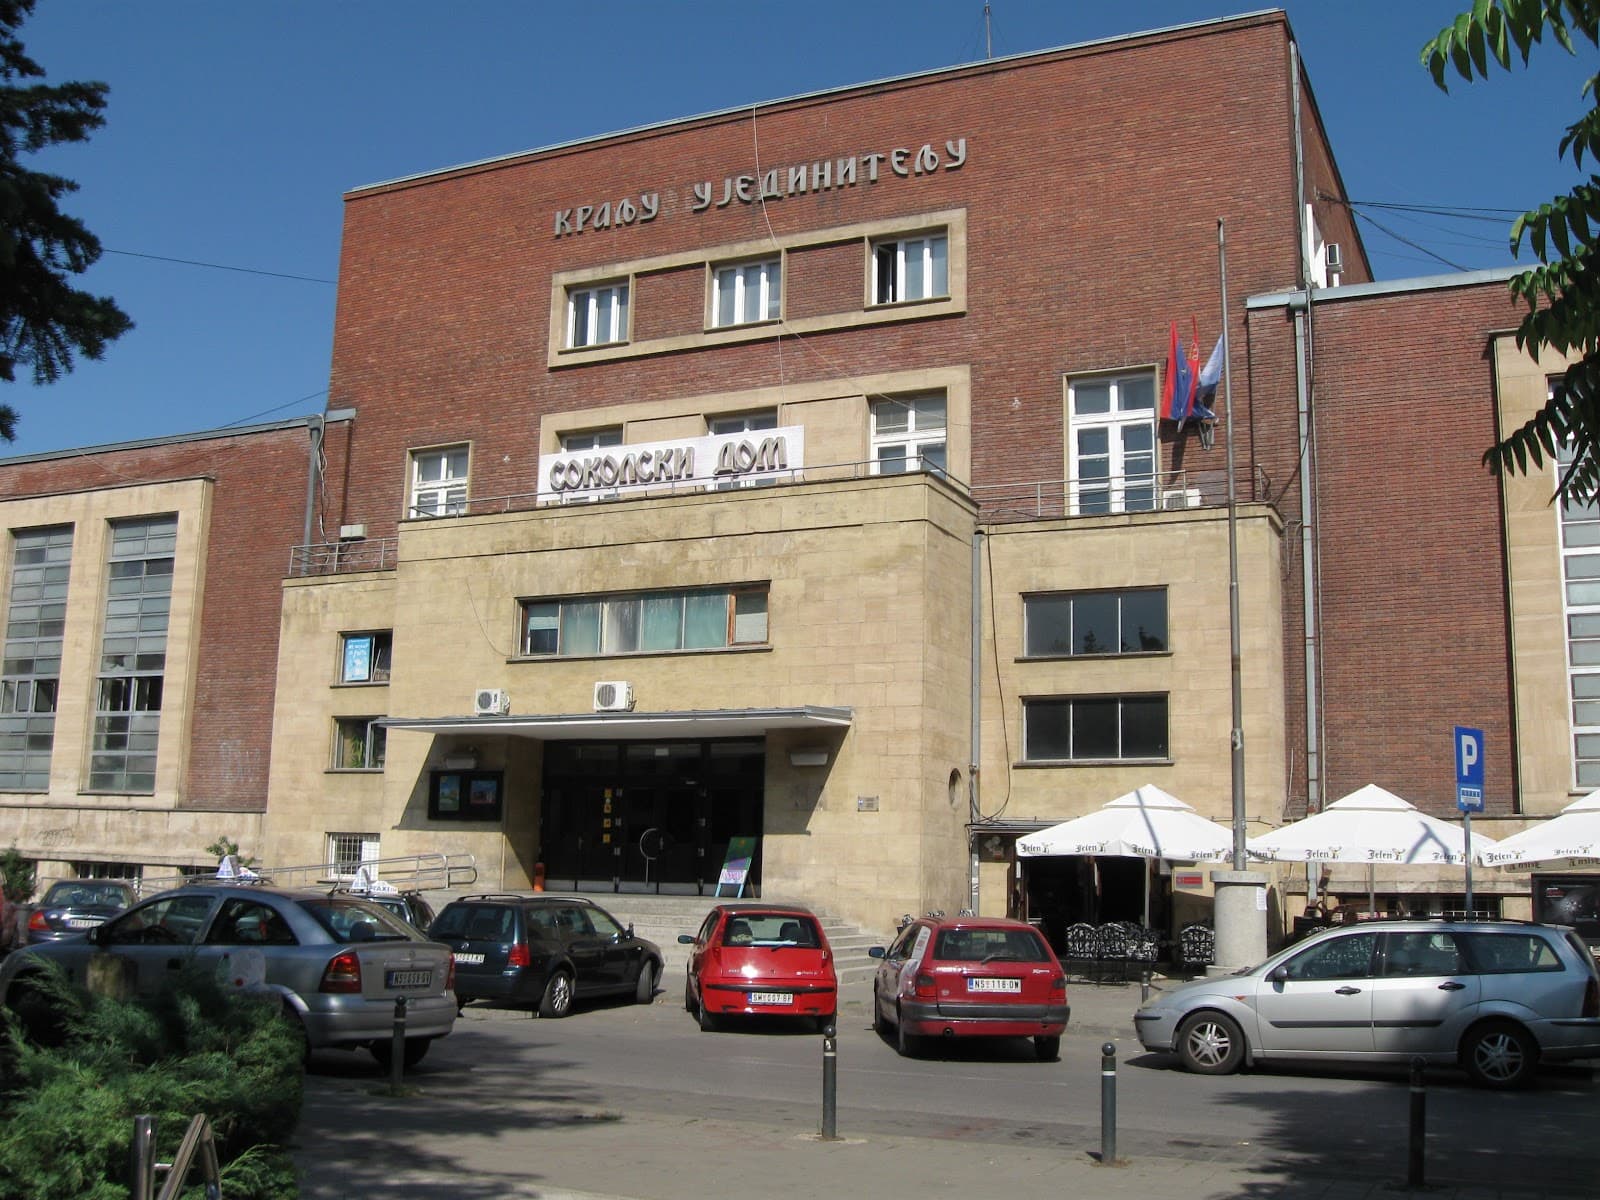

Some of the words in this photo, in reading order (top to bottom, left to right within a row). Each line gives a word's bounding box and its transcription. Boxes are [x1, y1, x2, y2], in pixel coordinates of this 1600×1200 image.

[554, 193, 659, 236] КРАЉУ
[693, 138, 967, 211] УЈЕДИНИТЕЉУ
[549, 446, 695, 491] СОКОЛСКИ
[713, 436, 788, 478] ДОМ
[1461, 734, 1478, 777] P
[1020, 843, 1041, 853] Jelen
[1305, 849, 1329, 860] Jelen
[1368, 849, 1392, 860] Jelen
[1486, 852, 1512, 863] Jelen
[975, 980, 985, 989] NS
